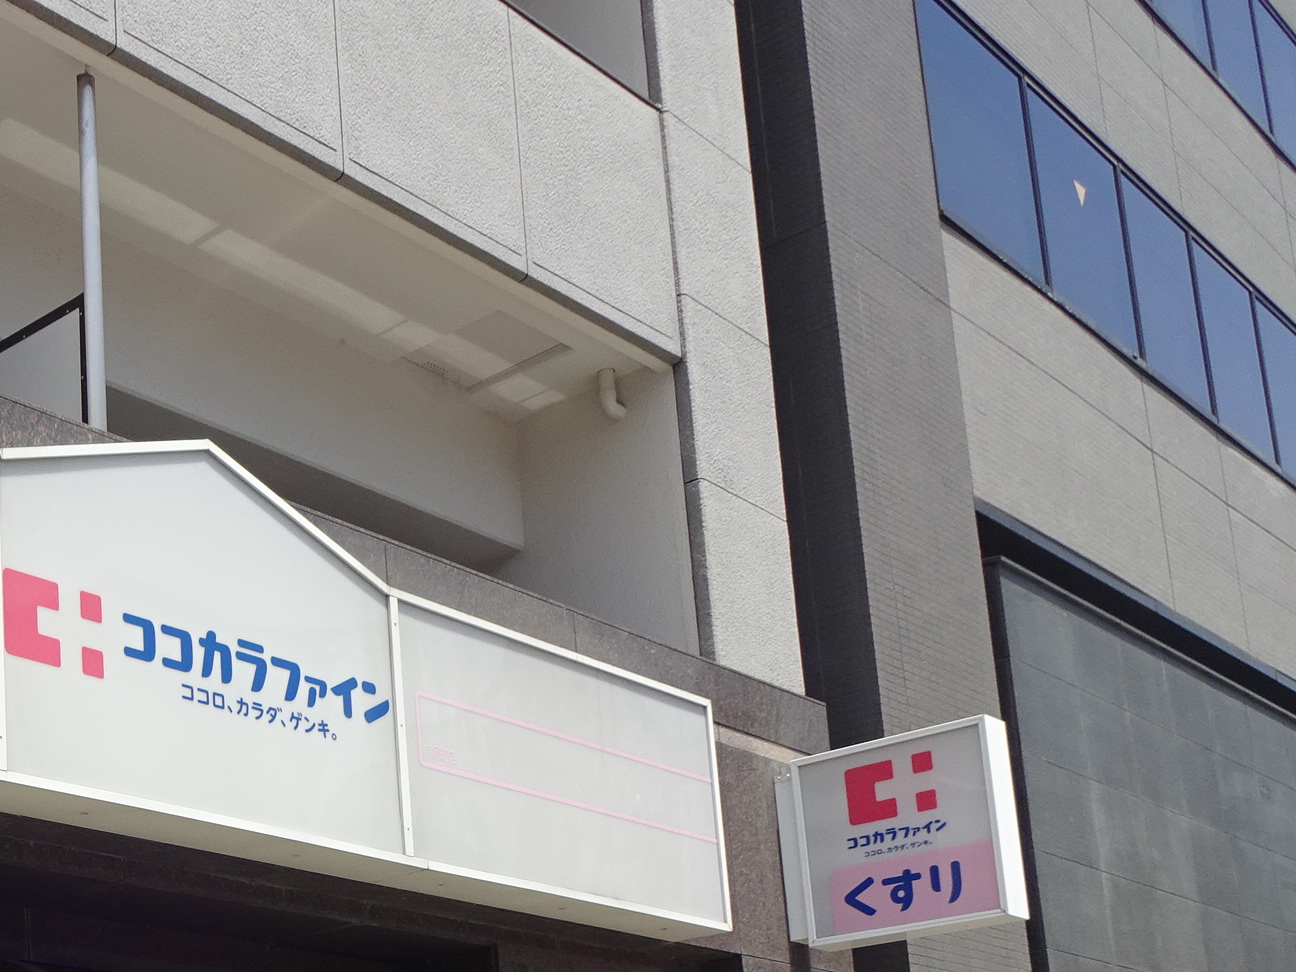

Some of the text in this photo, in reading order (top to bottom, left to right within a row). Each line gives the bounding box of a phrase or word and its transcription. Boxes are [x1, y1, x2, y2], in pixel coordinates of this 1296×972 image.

[122, 612, 390, 724] ココカラファイン
[181, 683, 338, 742] ココロ、カラダ、ゲンキ。
[846, 819, 947, 850] ココカラファイン
[844, 861, 962, 916] くすり
